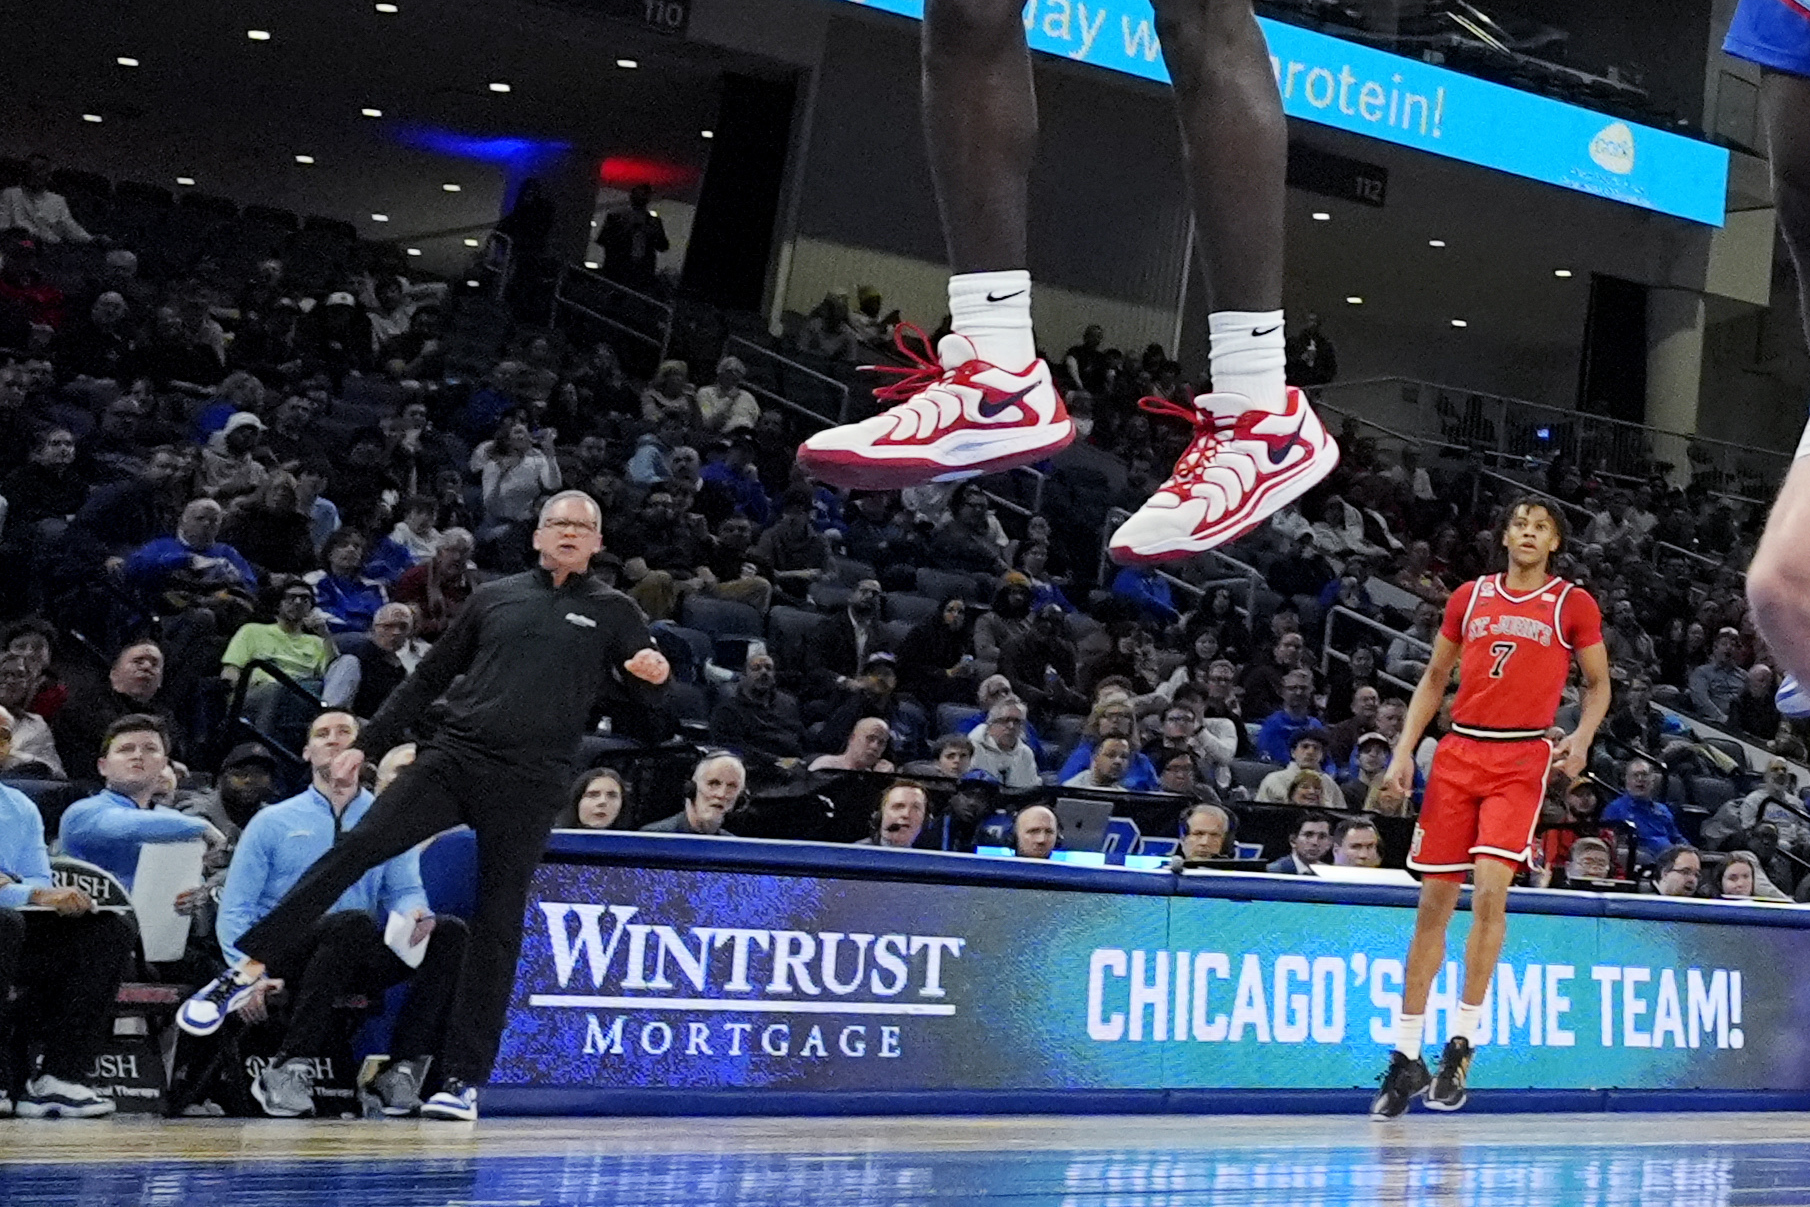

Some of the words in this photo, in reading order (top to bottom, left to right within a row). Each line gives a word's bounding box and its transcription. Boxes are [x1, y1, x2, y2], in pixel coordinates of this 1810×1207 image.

[1355, 176, 1382, 202] 112
[1489, 641, 1517, 678] 7
[539, 901, 966, 997] WINTRUST
[1087, 948, 1403, 1043] CHICAGO'S
[1591, 965, 1745, 1049] TEAM!
[583, 1014, 901, 1058] MORTGAGE
